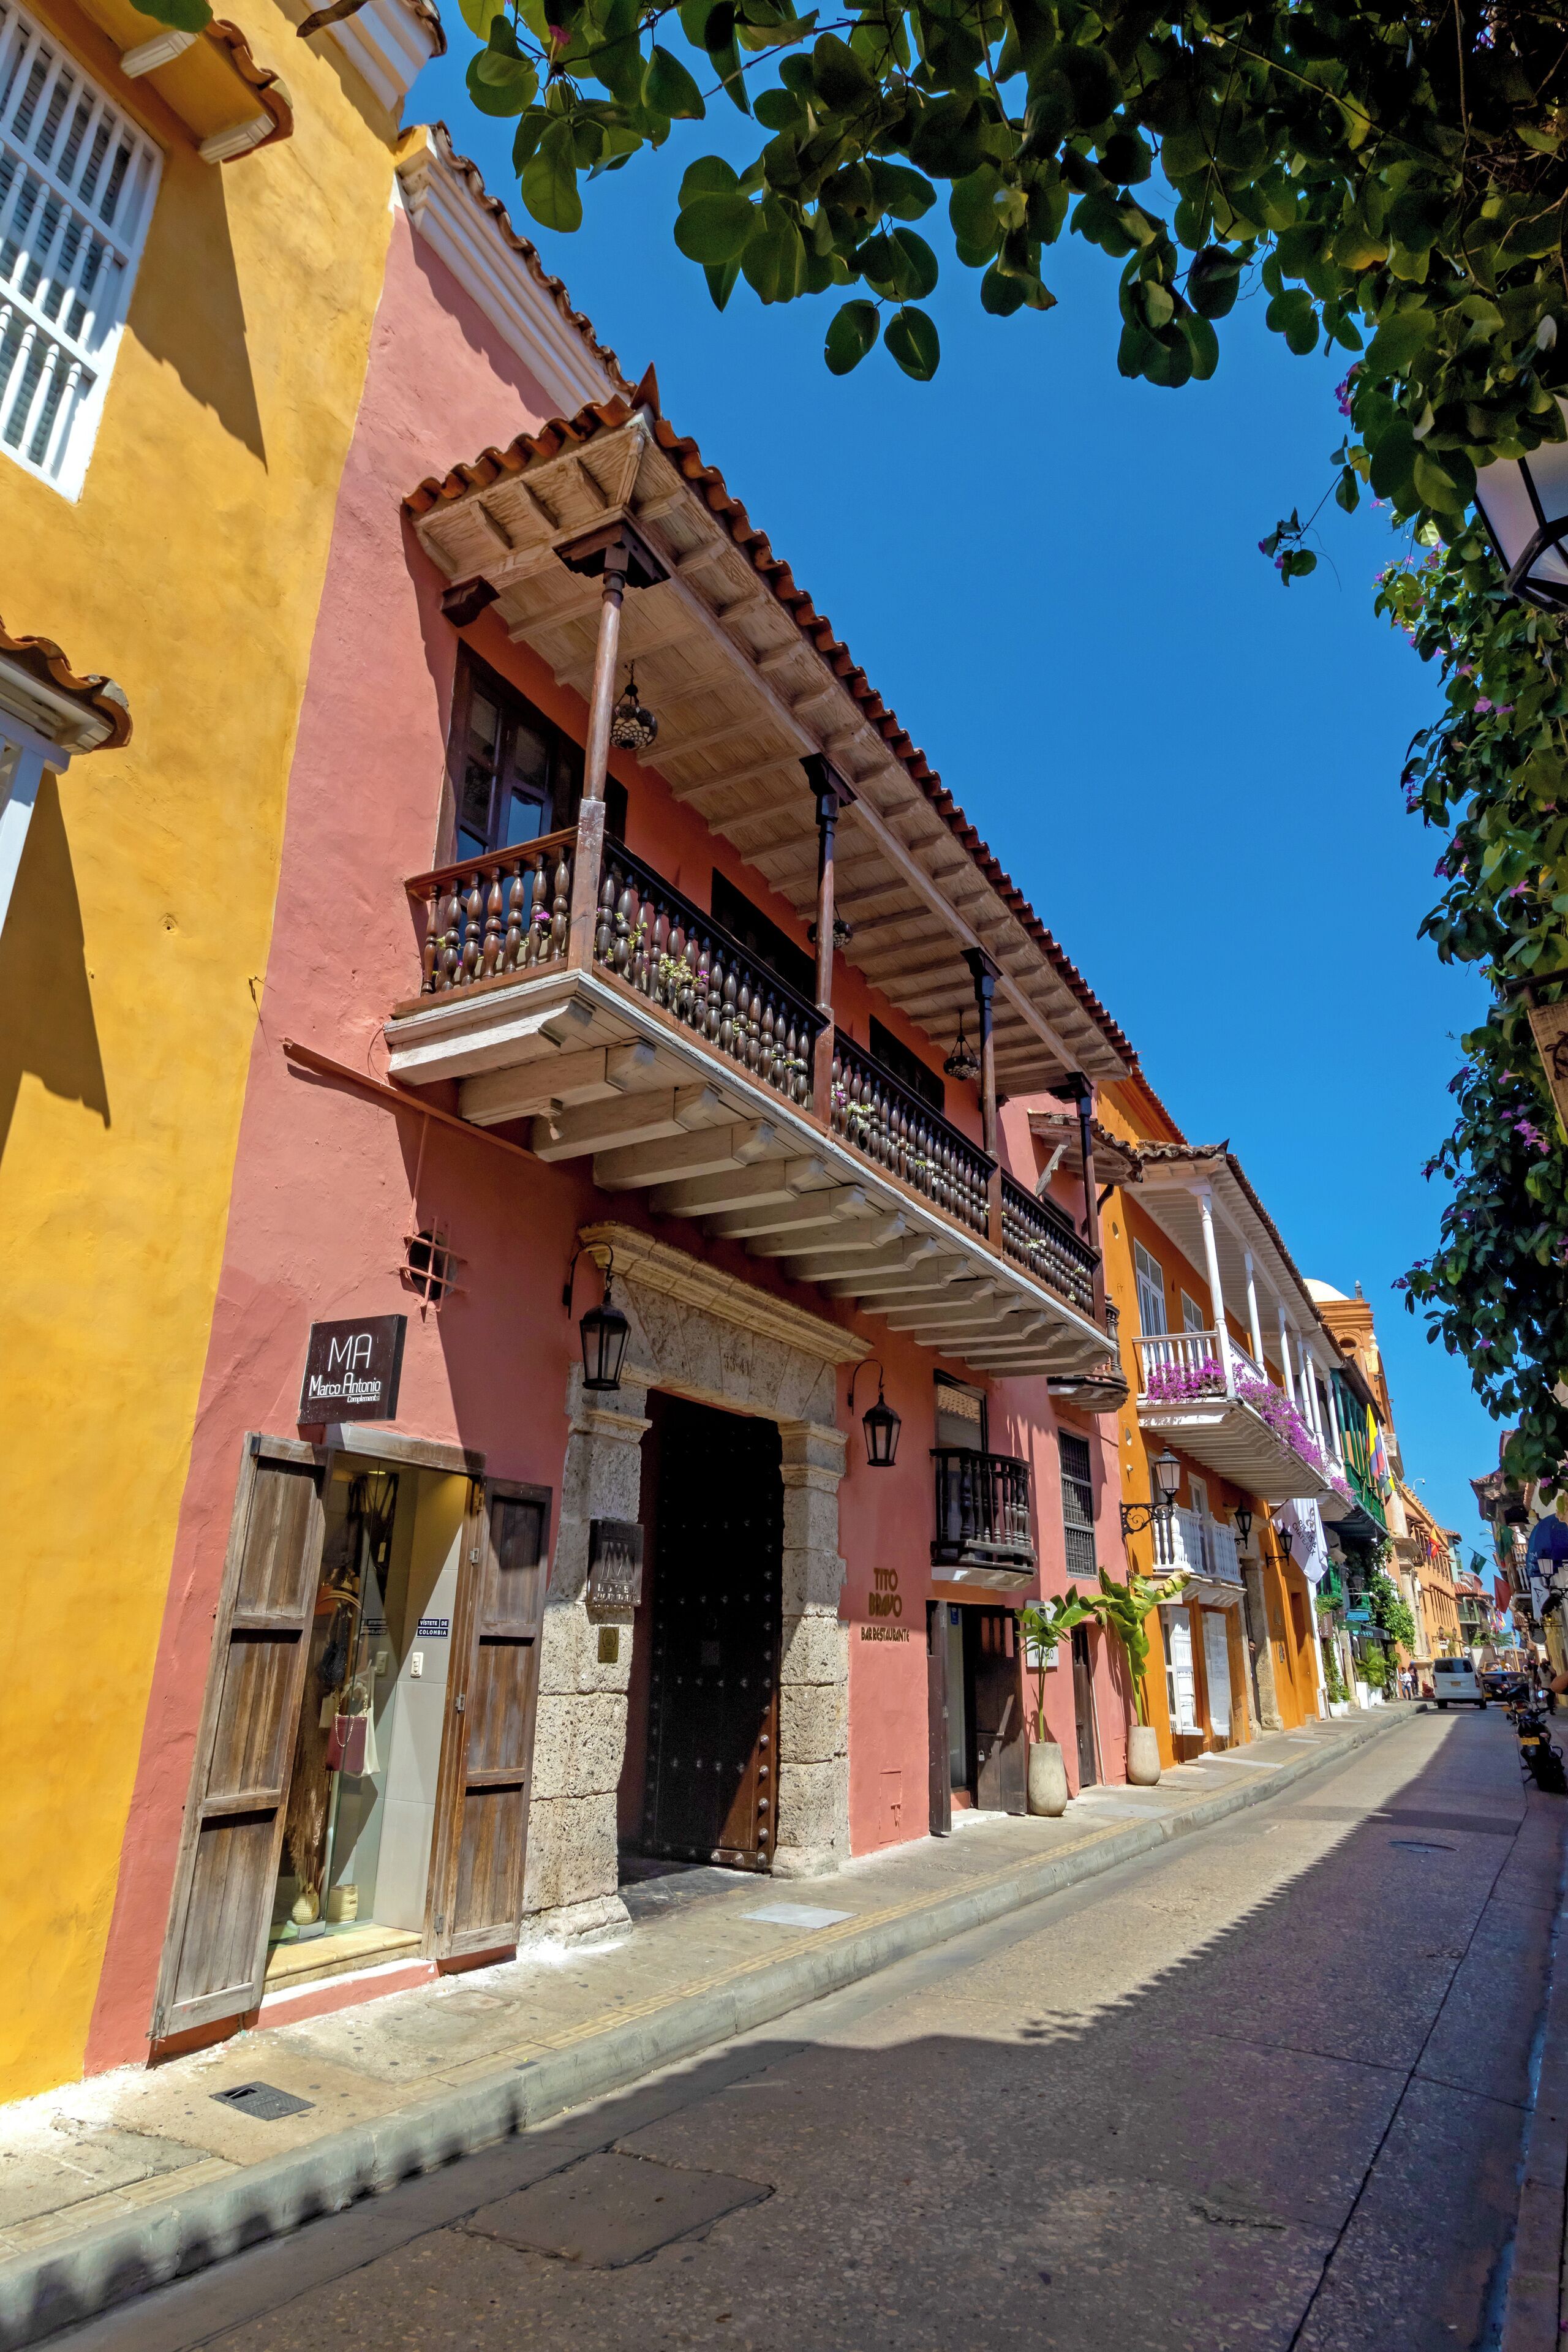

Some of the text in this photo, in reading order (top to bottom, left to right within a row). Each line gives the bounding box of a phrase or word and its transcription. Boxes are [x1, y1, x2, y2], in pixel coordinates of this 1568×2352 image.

[328, 1333, 372, 1372] MA
[308, 1372, 381, 1397] Marco Antonio
[347, 1395, 380, 1404] Complements
[1297, 1520, 1314, 1542] RELAIS
[597, 1583, 636, 1594] HOTEL
[873, 1567, 899, 1592] TITO
[861, 1626, 910, 1642] BAR RESTAURANTE
